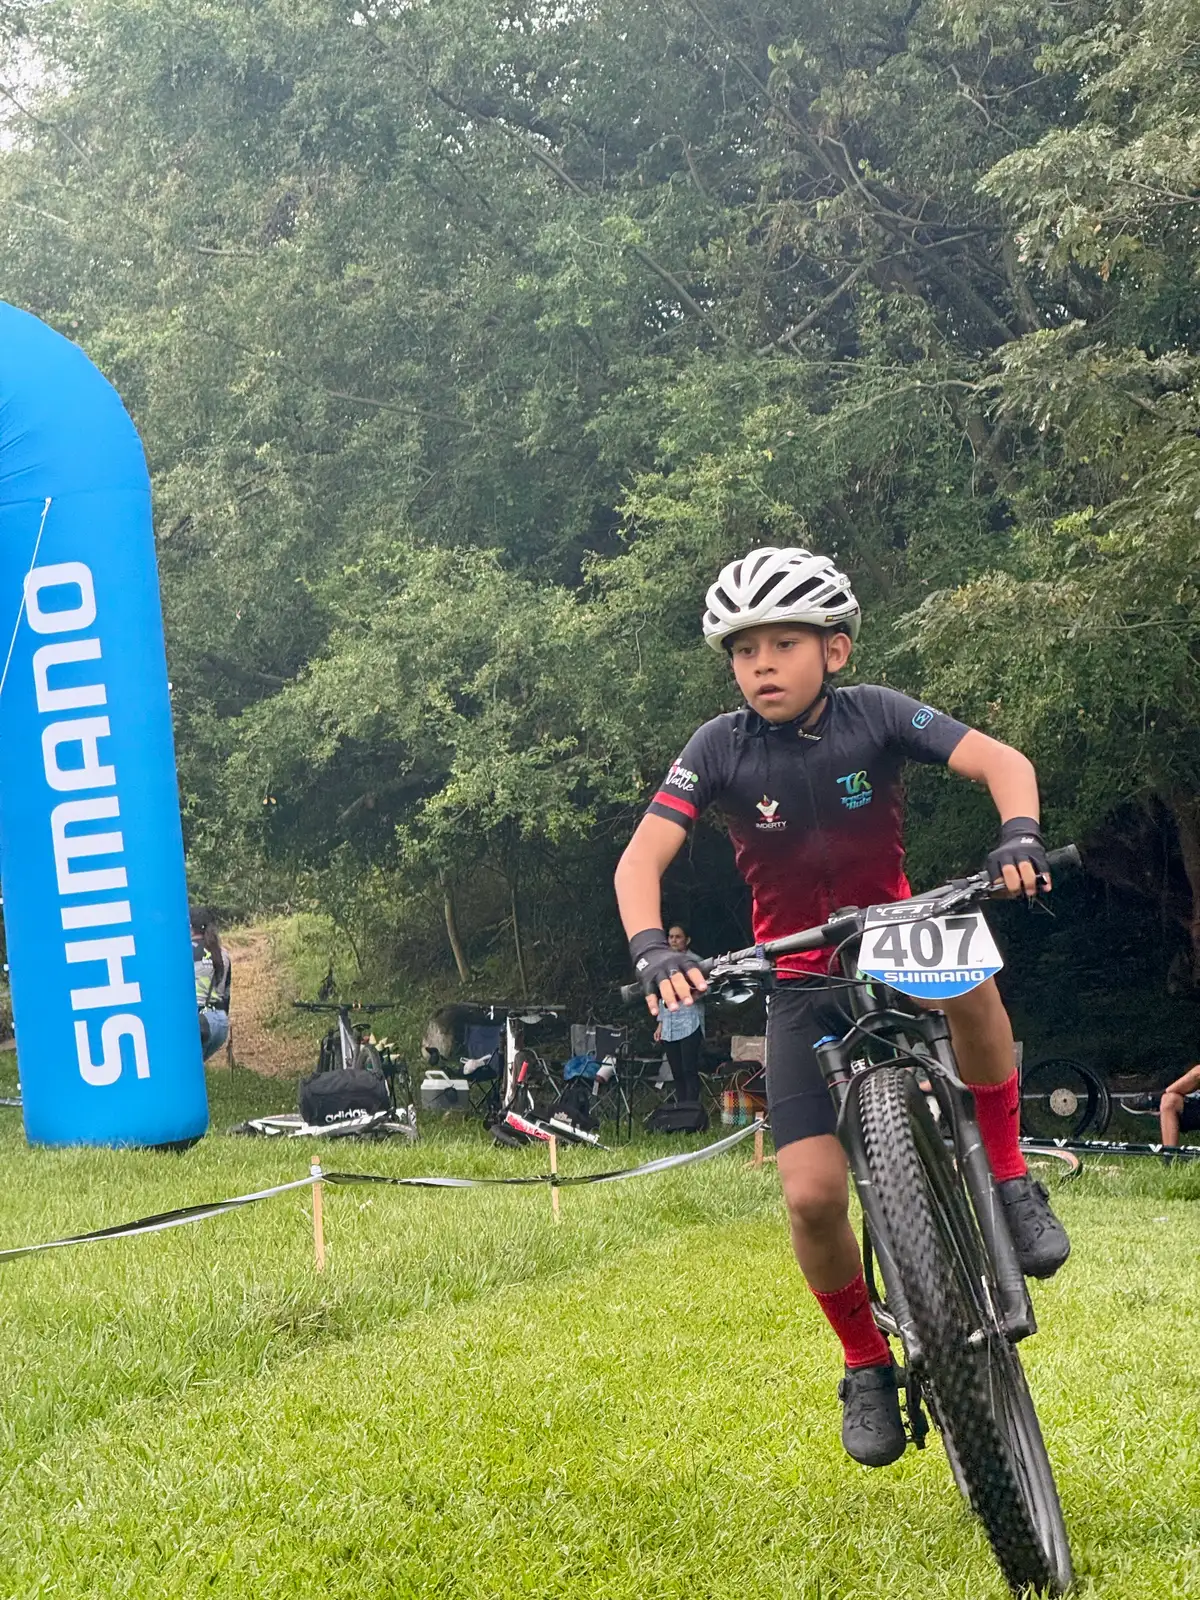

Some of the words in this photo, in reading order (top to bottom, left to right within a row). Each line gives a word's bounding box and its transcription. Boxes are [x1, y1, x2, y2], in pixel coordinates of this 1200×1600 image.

[23, 561, 151, 1086] SHIMANO
[872, 916, 979, 968] 407
[883, 970, 985, 983] SHIMANO
[325, 1108, 369, 1123] adidas
